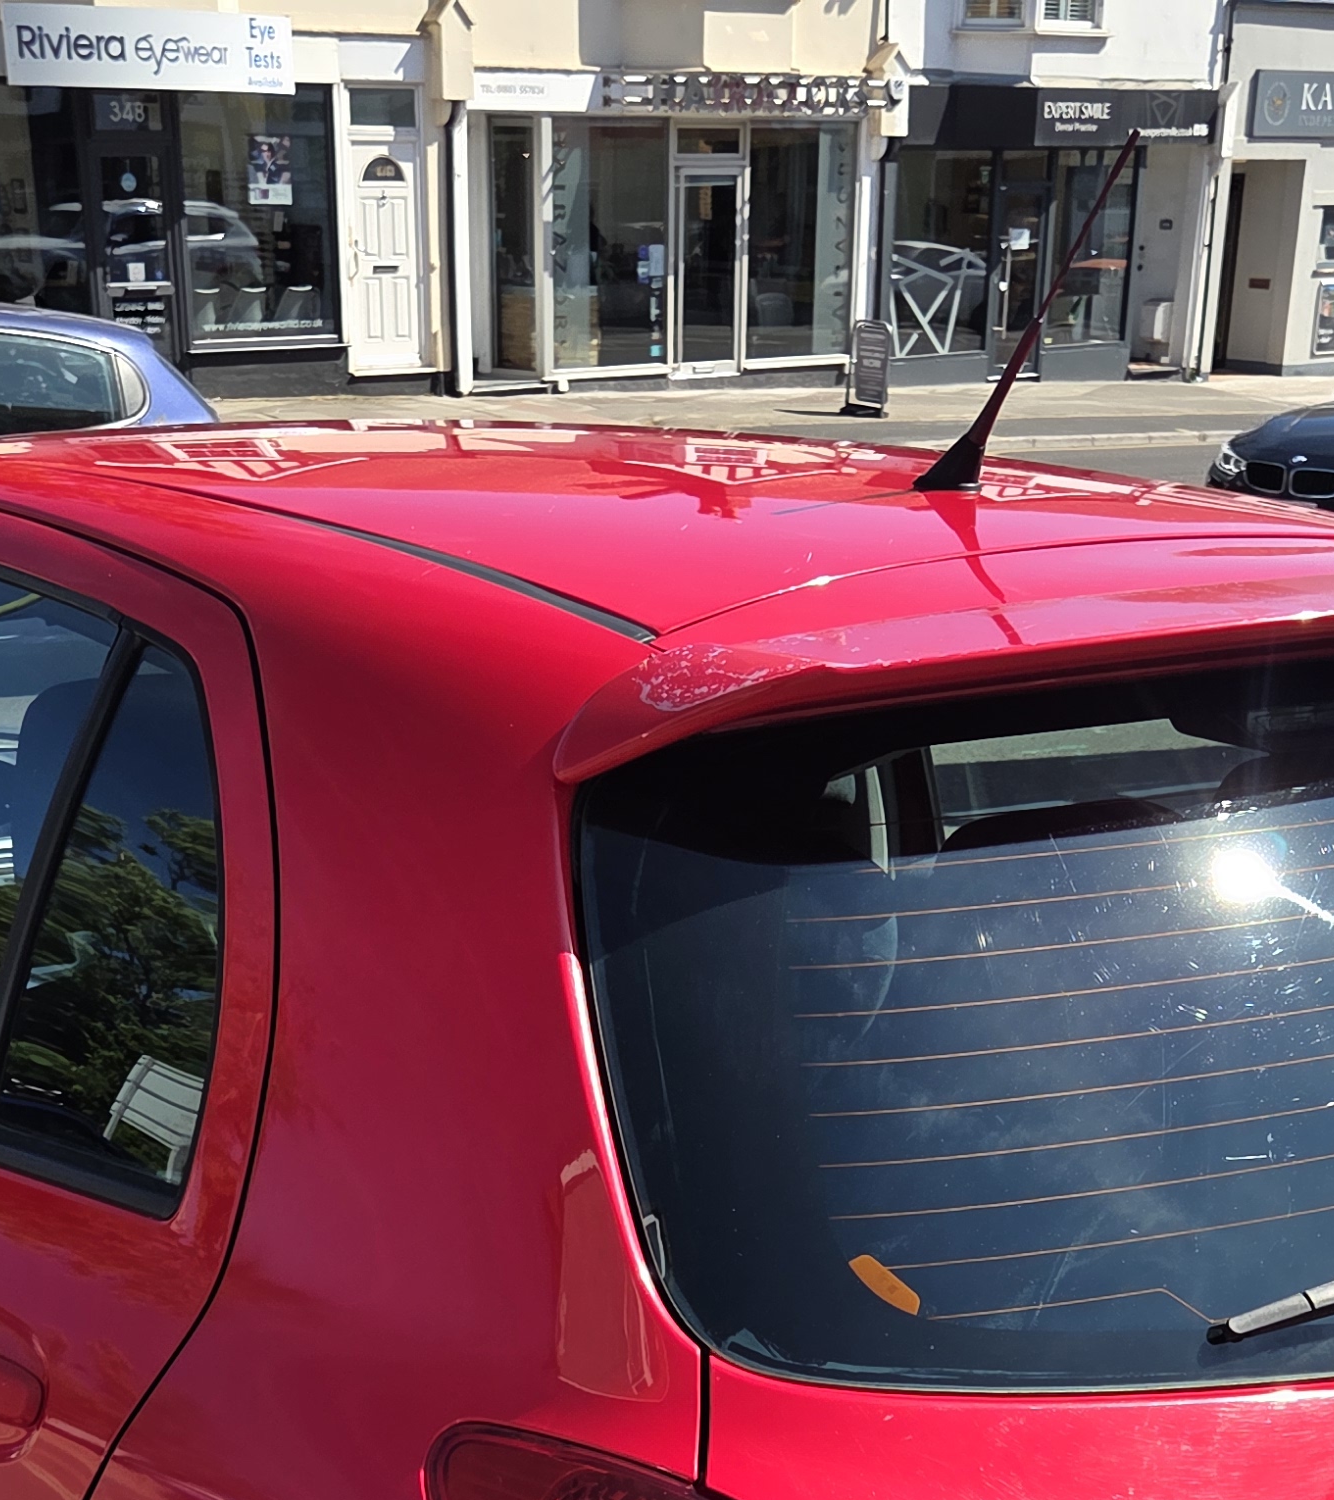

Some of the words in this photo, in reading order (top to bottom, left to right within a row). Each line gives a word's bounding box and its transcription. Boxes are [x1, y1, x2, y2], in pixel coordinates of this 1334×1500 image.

[248, 17, 276, 44] Eye
[16, 25, 127, 62] Riviera
[134, 34, 228, 75] eyewear
[246, 46, 282, 70] Tests
[109, 101, 146, 123] 348
[1043, 102, 1079, 119] EXPERT
[1080, 102, 1112, 119] SMILE
